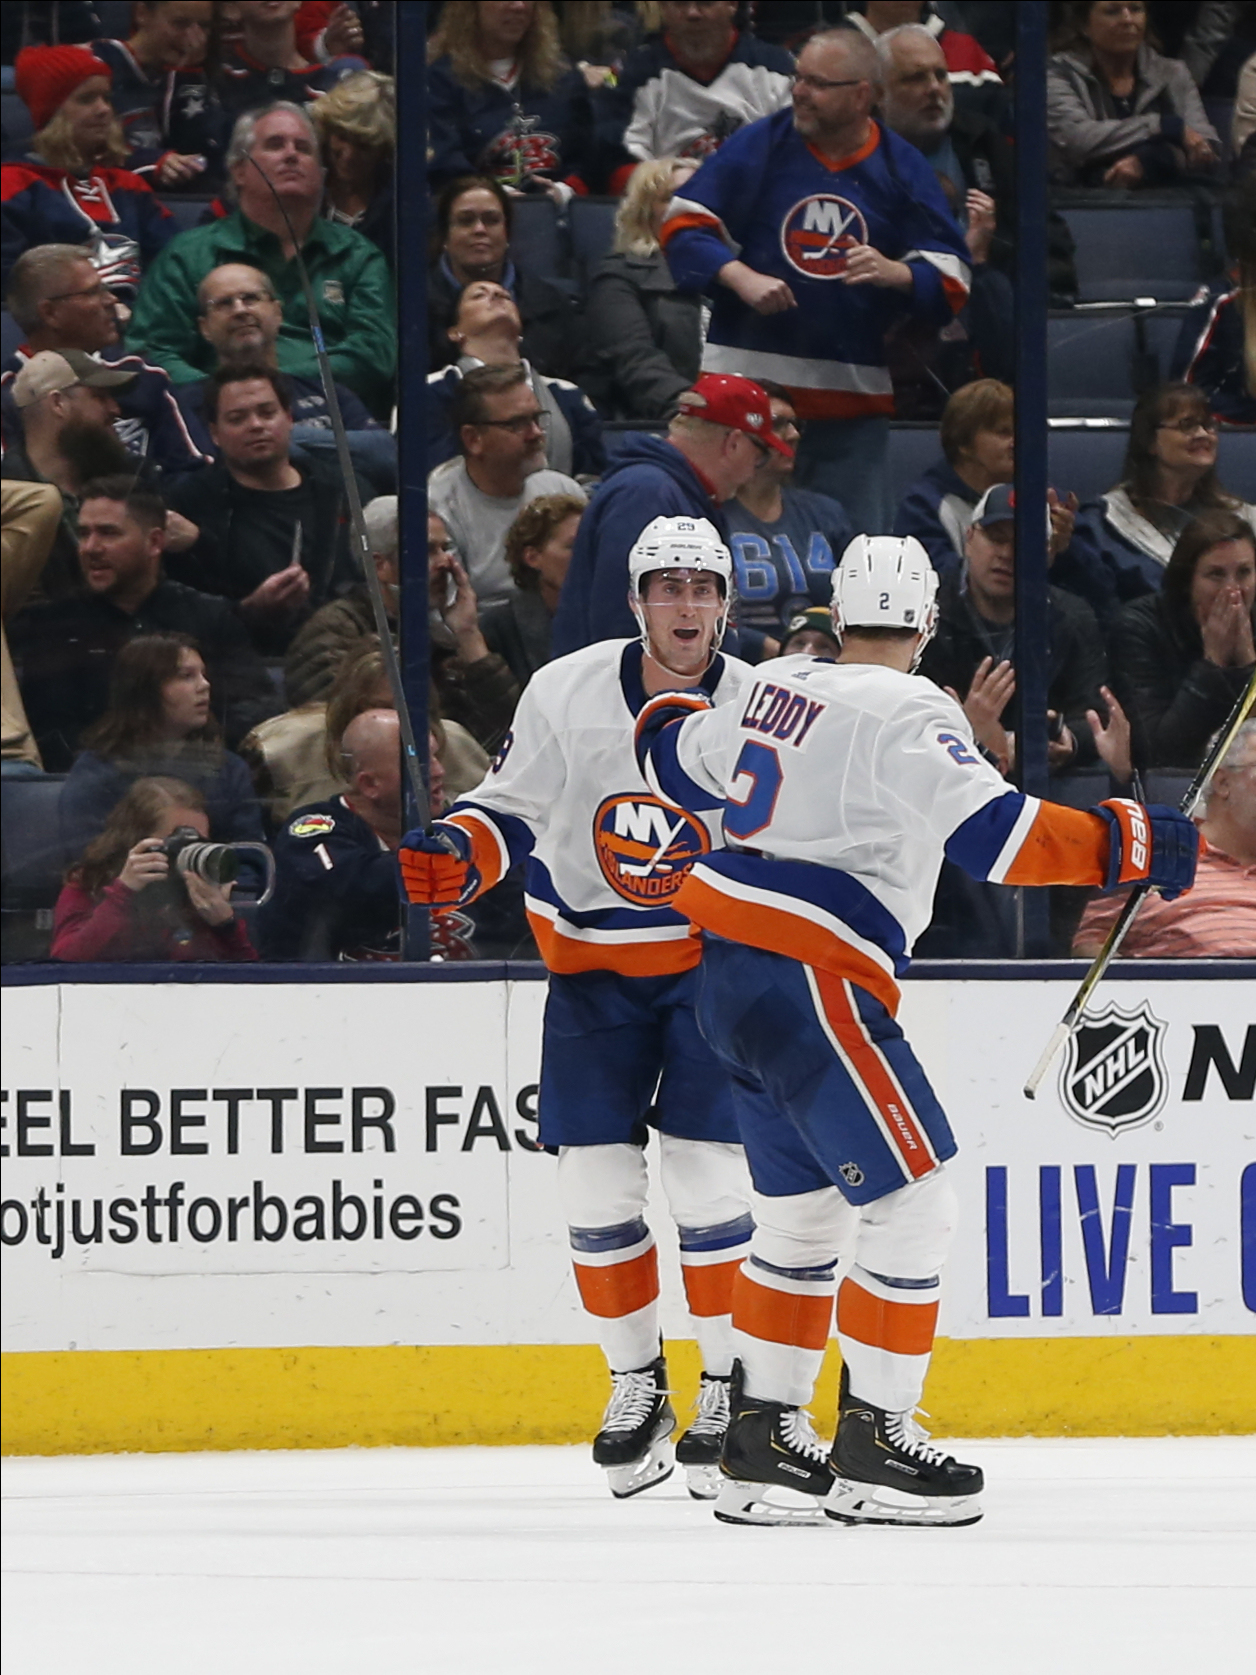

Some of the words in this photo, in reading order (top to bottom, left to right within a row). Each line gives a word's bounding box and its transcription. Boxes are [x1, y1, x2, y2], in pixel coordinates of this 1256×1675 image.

[731, 531, 836, 601] 614
[879, 592, 890, 610] 2
[740, 681, 827, 747] LEDDY
[937, 733, 981, 765] 2
[1084, 1037, 1146, 1107] NHL
[120, 1087, 396, 1156] BETTER
[886, 1103, 918, 1150] BAUER
[985, 1163, 1199, 1318] LIVE
